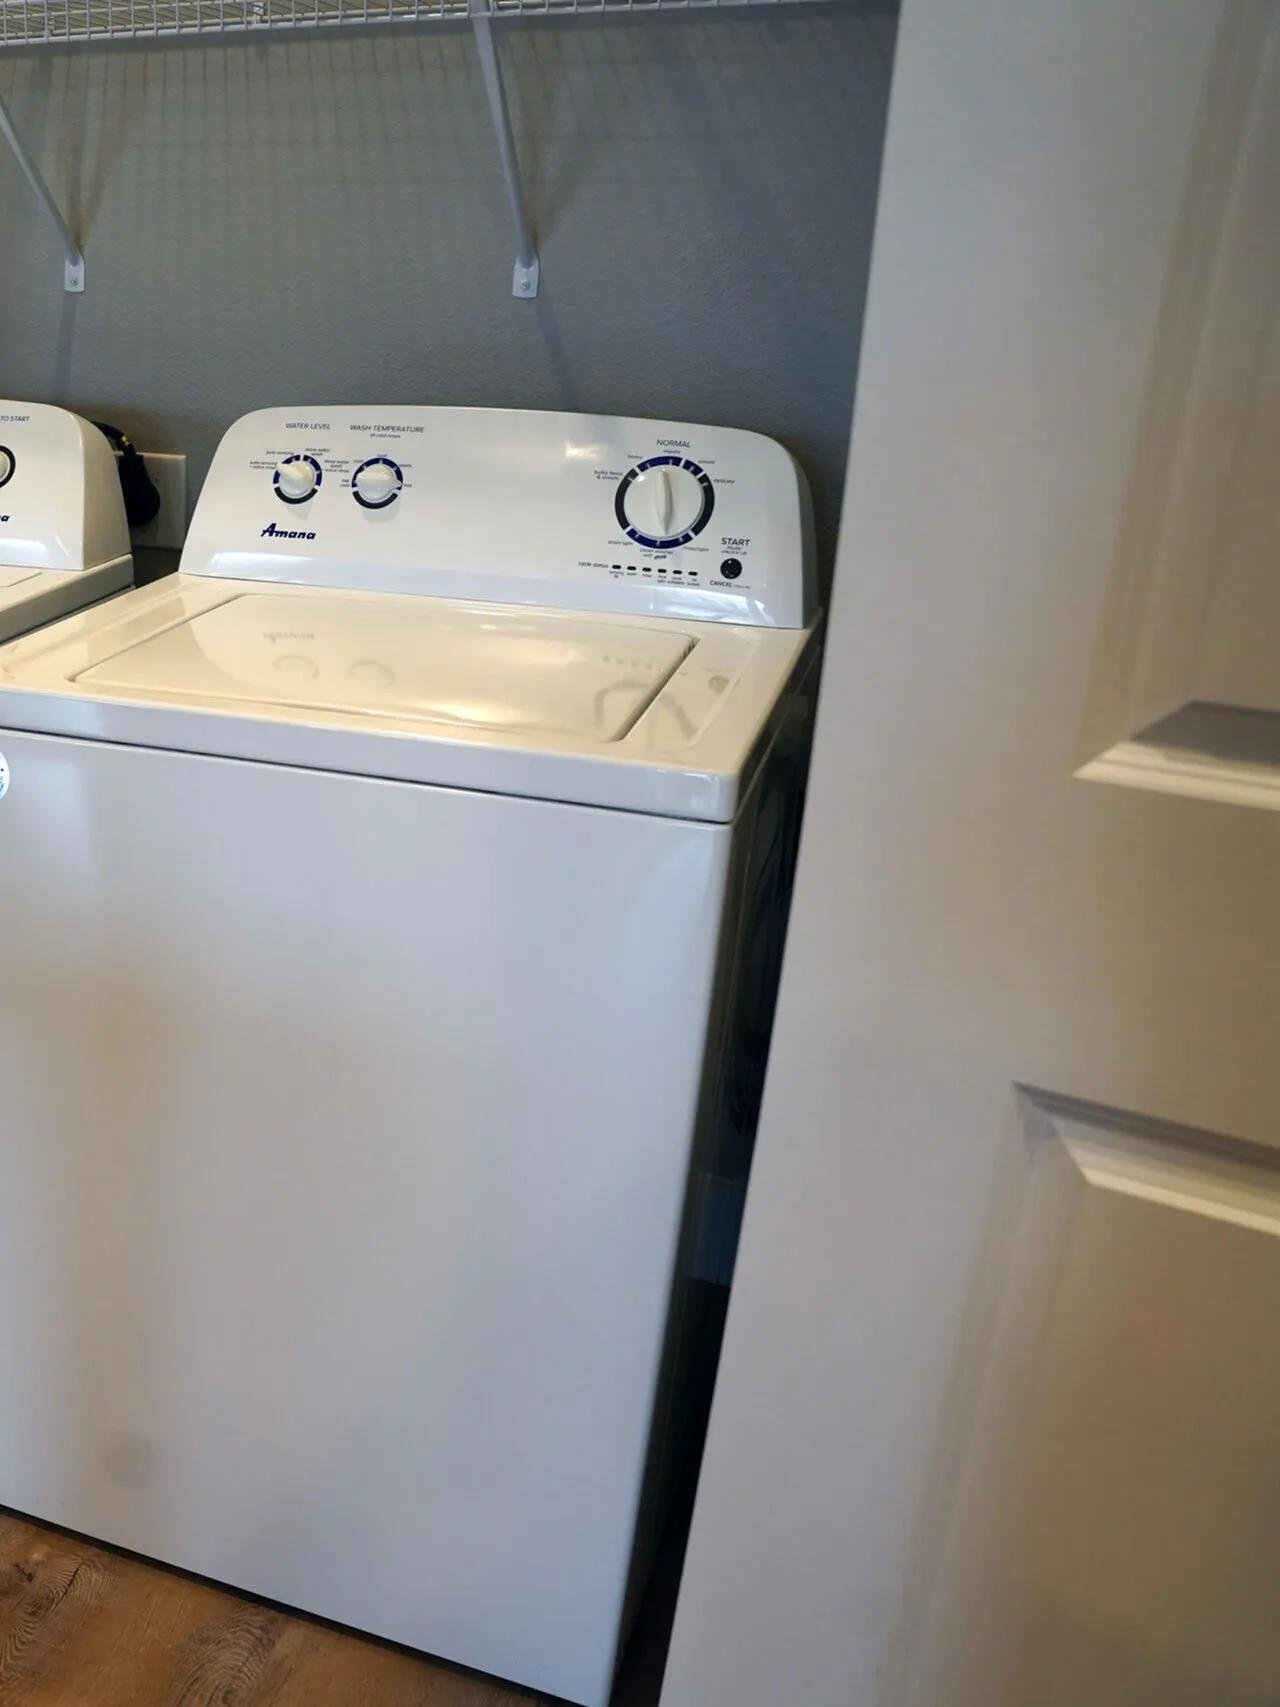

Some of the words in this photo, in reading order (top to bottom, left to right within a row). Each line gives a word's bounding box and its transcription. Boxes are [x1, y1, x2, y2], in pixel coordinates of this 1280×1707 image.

[373, 425, 424, 433] TEMPERATURE
[657, 440, 691, 448] NORMAL
[261, 523, 316, 539] Amana
[721, 537, 750, 546] START
